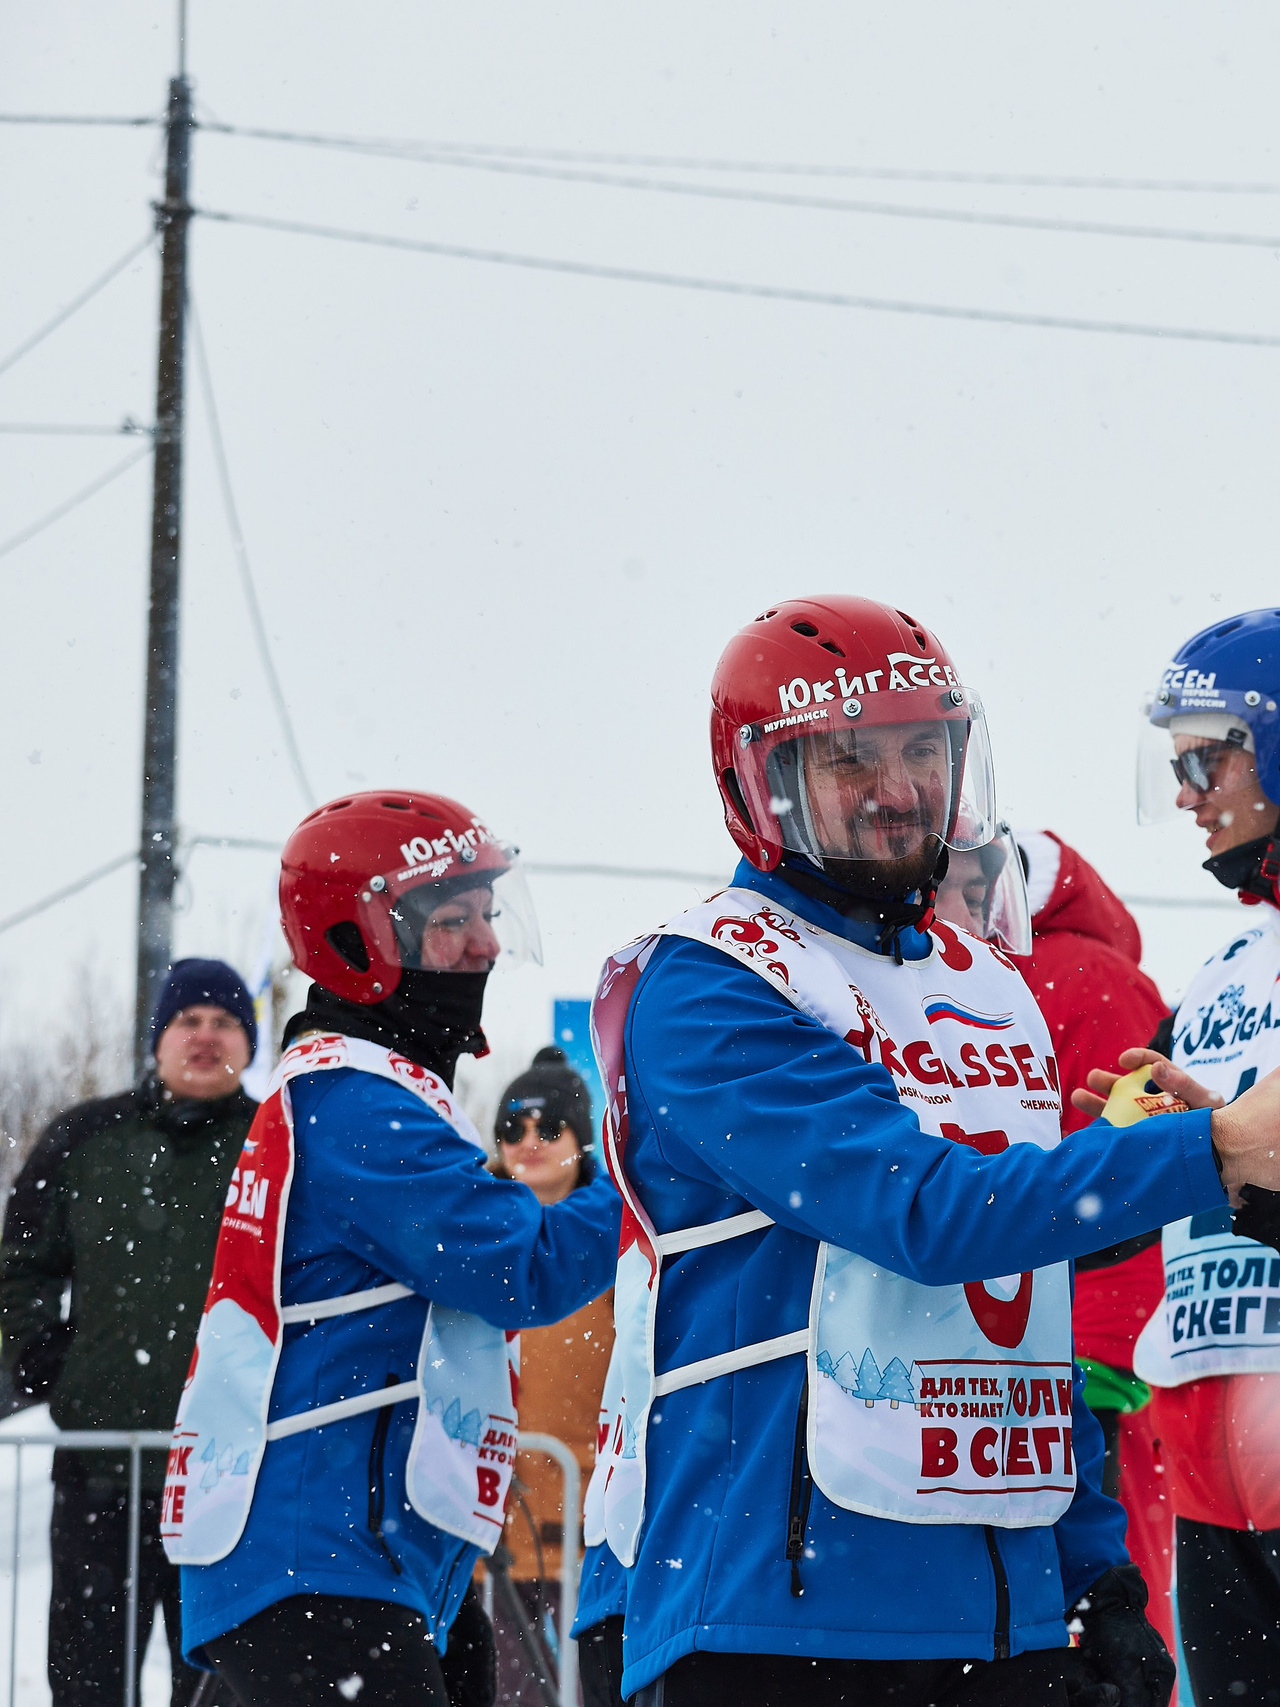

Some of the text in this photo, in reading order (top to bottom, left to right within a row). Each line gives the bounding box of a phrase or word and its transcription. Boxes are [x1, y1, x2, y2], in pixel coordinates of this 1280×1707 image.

[763, 707, 829, 734] МУРМАНСК
[920, 1377, 1003, 1399] ДЛЯ ТЕХ,
[920, 1402, 1004, 1418] КТО ЗНАЕТ
[478, 1446, 507, 1463] КТО
[921, 1426, 1073, 1478] В СЕГ
[476, 1465, 501, 1507] В
